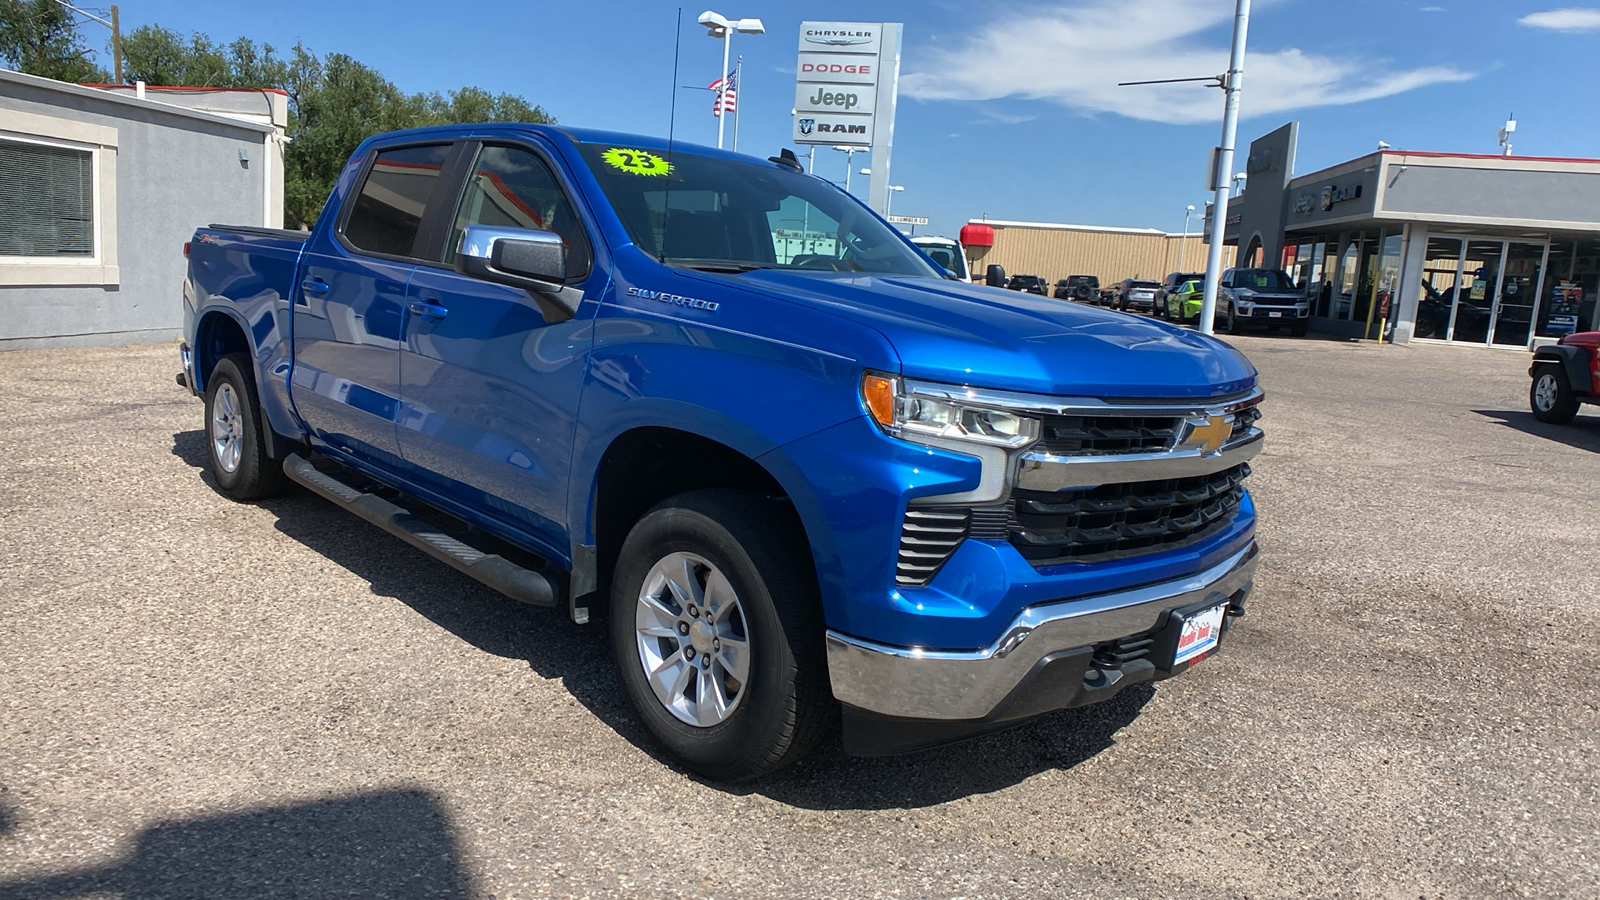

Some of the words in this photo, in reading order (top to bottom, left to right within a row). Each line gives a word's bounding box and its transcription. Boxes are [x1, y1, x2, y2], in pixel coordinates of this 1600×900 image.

[802, 64, 871, 74] DODGE
[810, 88, 858, 110] Jeep
[817, 124, 866, 134] RAM
[618, 153, 655, 168] 23
[626, 287, 720, 311] SILVERADO
